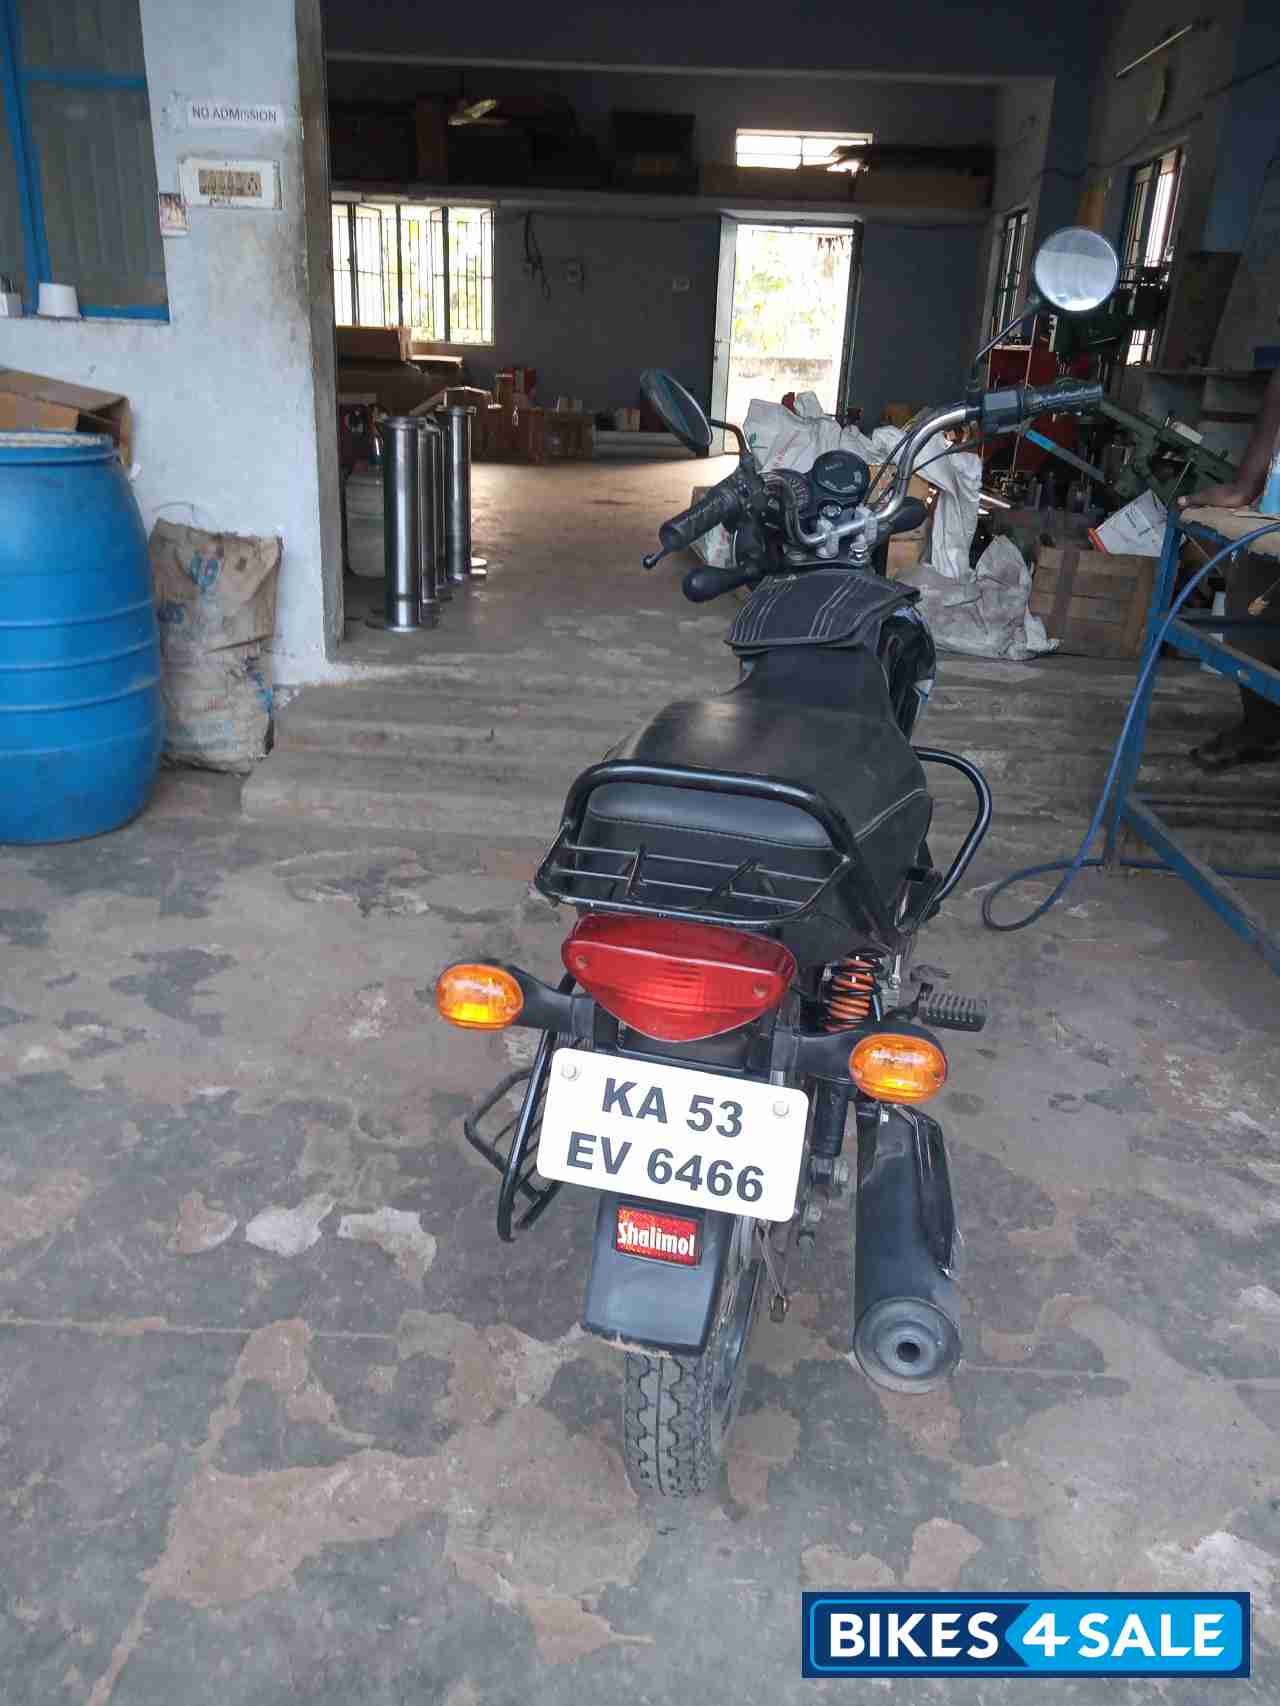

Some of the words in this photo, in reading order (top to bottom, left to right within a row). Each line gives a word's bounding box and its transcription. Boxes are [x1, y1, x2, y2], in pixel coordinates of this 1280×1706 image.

[192, 104, 210, 119] NO
[602, 1078, 668, 1124] KA
[686, 1094, 743, 1138] 53
[566, 1131, 632, 1176] EV
[647, 1148, 764, 1203] 6466
